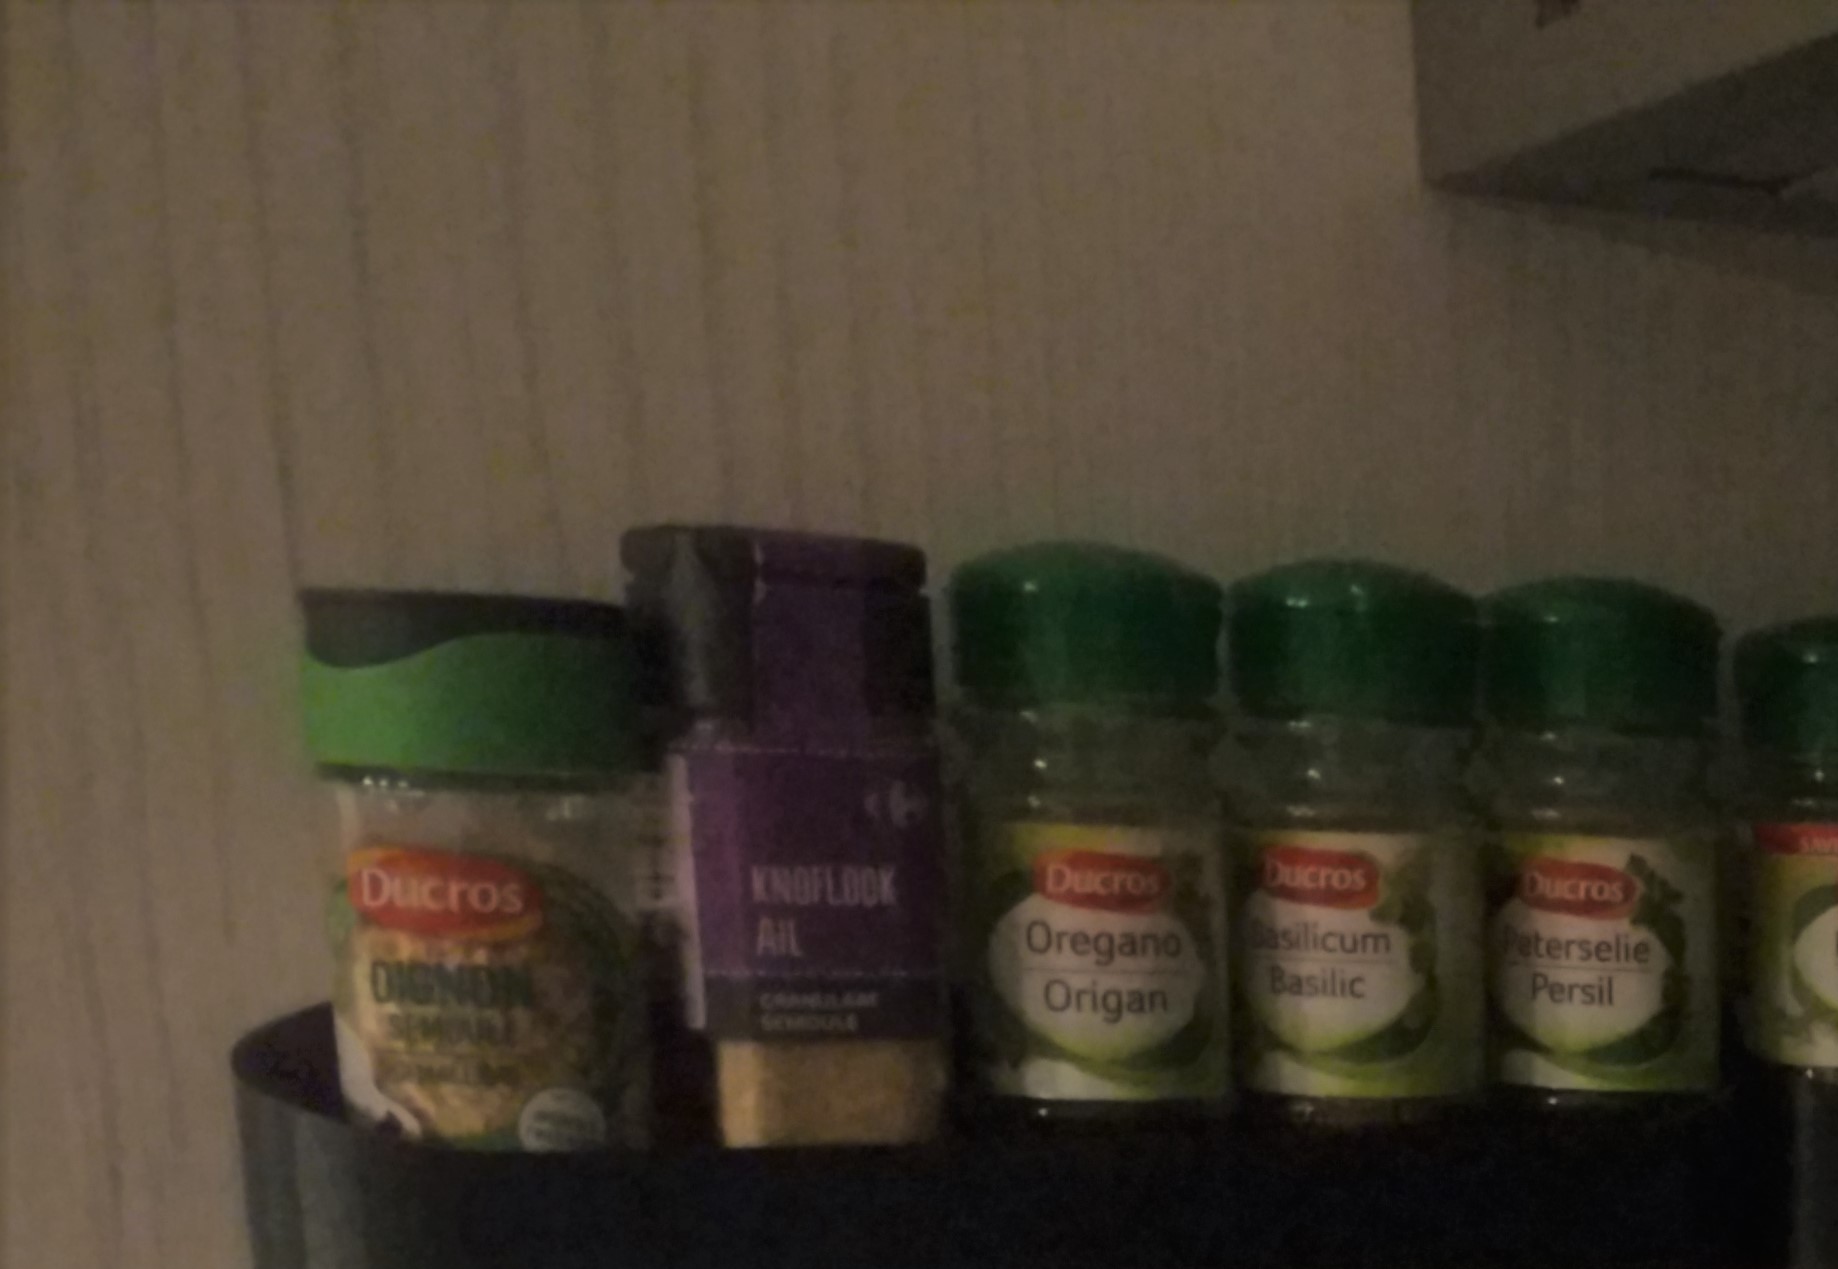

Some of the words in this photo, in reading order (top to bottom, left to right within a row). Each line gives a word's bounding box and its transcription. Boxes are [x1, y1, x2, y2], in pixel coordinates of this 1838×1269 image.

[361, 866, 524, 914] Ducros
[751, 865, 898, 906] KNOFLOOK
[1045, 863, 1160, 896] Ducros
[1262, 858, 1367, 890] Ducros
[1523, 871, 1625, 902] Ducros
[757, 916, 804, 957] AIL
[1026, 920, 1182, 966] Oregano
[1248, 918, 1391, 954] Basilicum
[1504, 925, 1652, 963] Peterselie
[1043, 979, 1168, 1022] Origan
[1270, 965, 1366, 999] Basilic
[1531, 973, 1615, 1006] Persil
